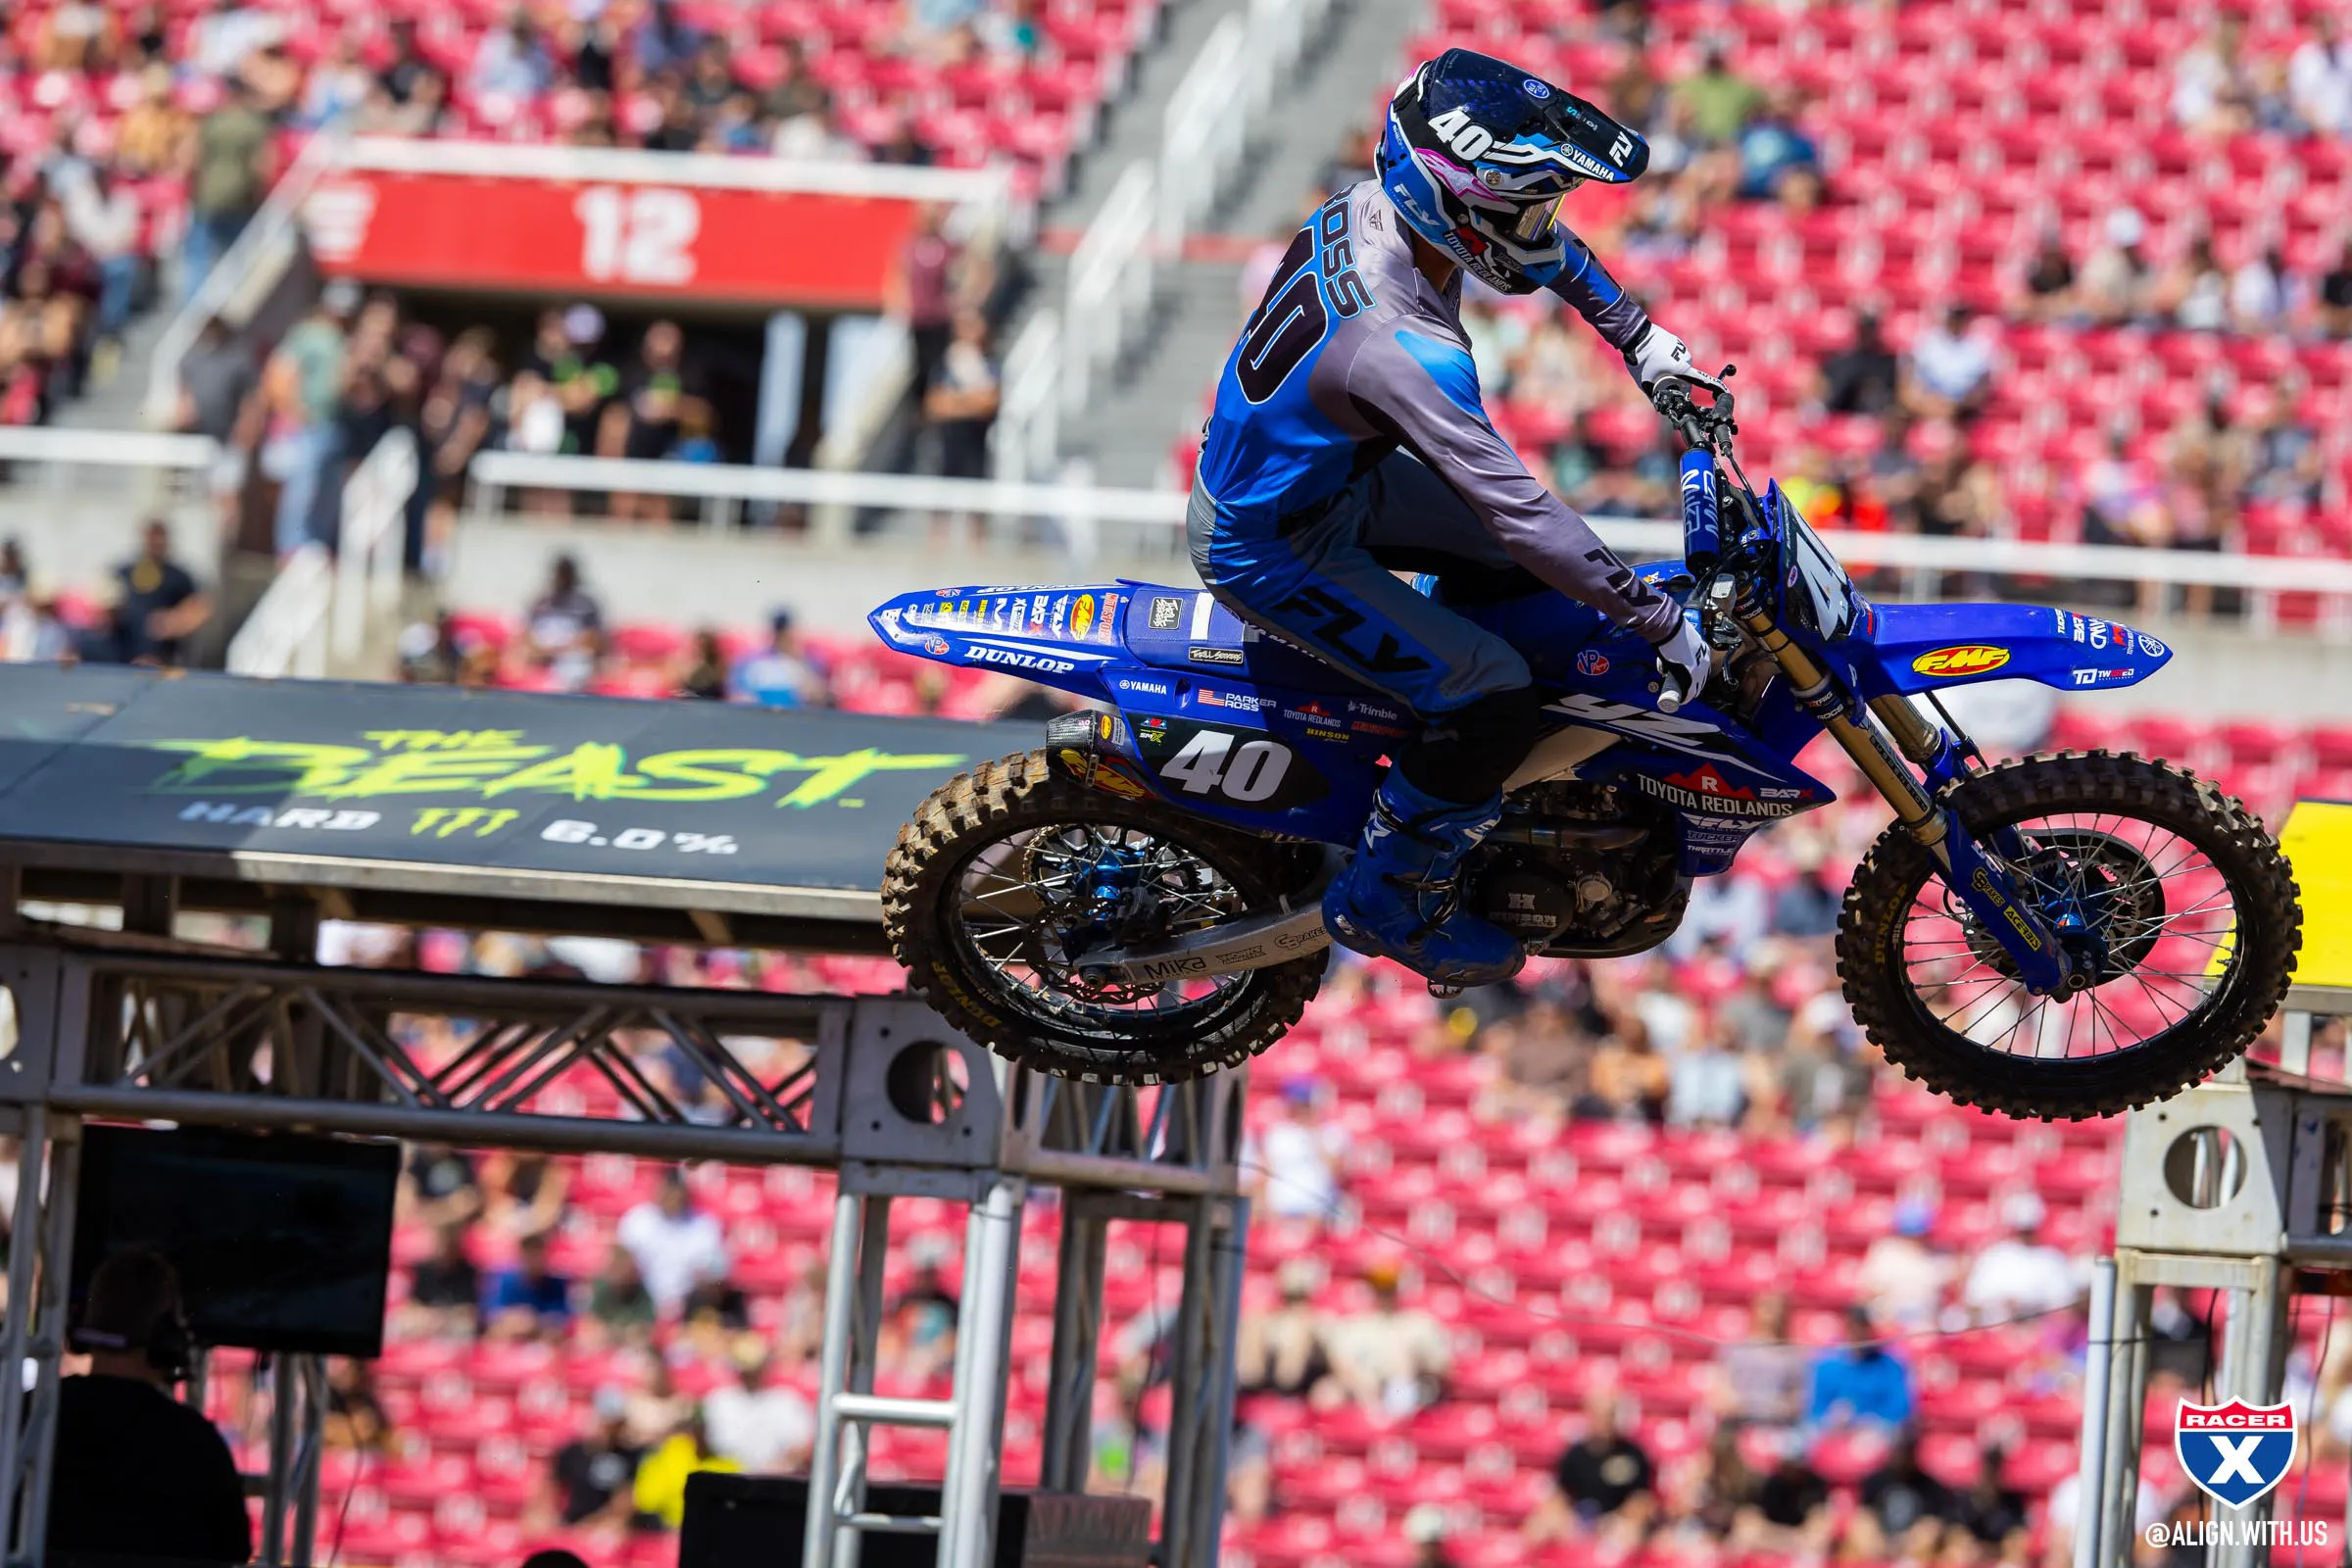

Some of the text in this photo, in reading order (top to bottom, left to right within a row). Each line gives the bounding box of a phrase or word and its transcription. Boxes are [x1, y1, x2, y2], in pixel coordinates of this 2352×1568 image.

[1428, 109, 1494, 161] 40
[1608, 131, 1634, 169] FLY
[1572, 150, 1615, 181] YAMAHA
[1393, 183, 1441, 225] FLY
[576, 186, 702, 285] 12
[1444, 232, 1511, 292] TOYOTA REDLANDS
[1671, 339, 1687, 362] FLY
[1583, 546, 1664, 608] FLY
[1029, 595, 1049, 635] BARX
[1053, 594, 1068, 639] FLY
[1270, 586, 1434, 673] FLY
[964, 646, 1074, 674] DUNLOP
[1695, 643, 1707, 666] FL
[1914, 649, 2009, 672] FMF
[1130, 680, 1167, 695] YAMAHA
[1226, 693, 1277, 708] PARKER
[1225, 700, 1260, 712] ROSS
[1284, 710, 1342, 728] TOYOTA REDLANDS
[1359, 703, 1397, 720] Trimble
[365, 728, 526, 753] THE
[1306, 728, 1349, 741] HINSON
[147, 736, 968, 808] BEAST
[1159, 729, 1293, 802] 40
[1637, 773, 1793, 816] TOYOTA REDLANDS
[1701, 776, 1719, 791] R
[1760, 787, 1813, 799] BARX
[177, 800, 739, 856] HARD 6.0%
[1680, 811, 1763, 829] FLY
[2006, 909, 2041, 950] ACERBIS
[1144, 956, 1206, 979] Mika
